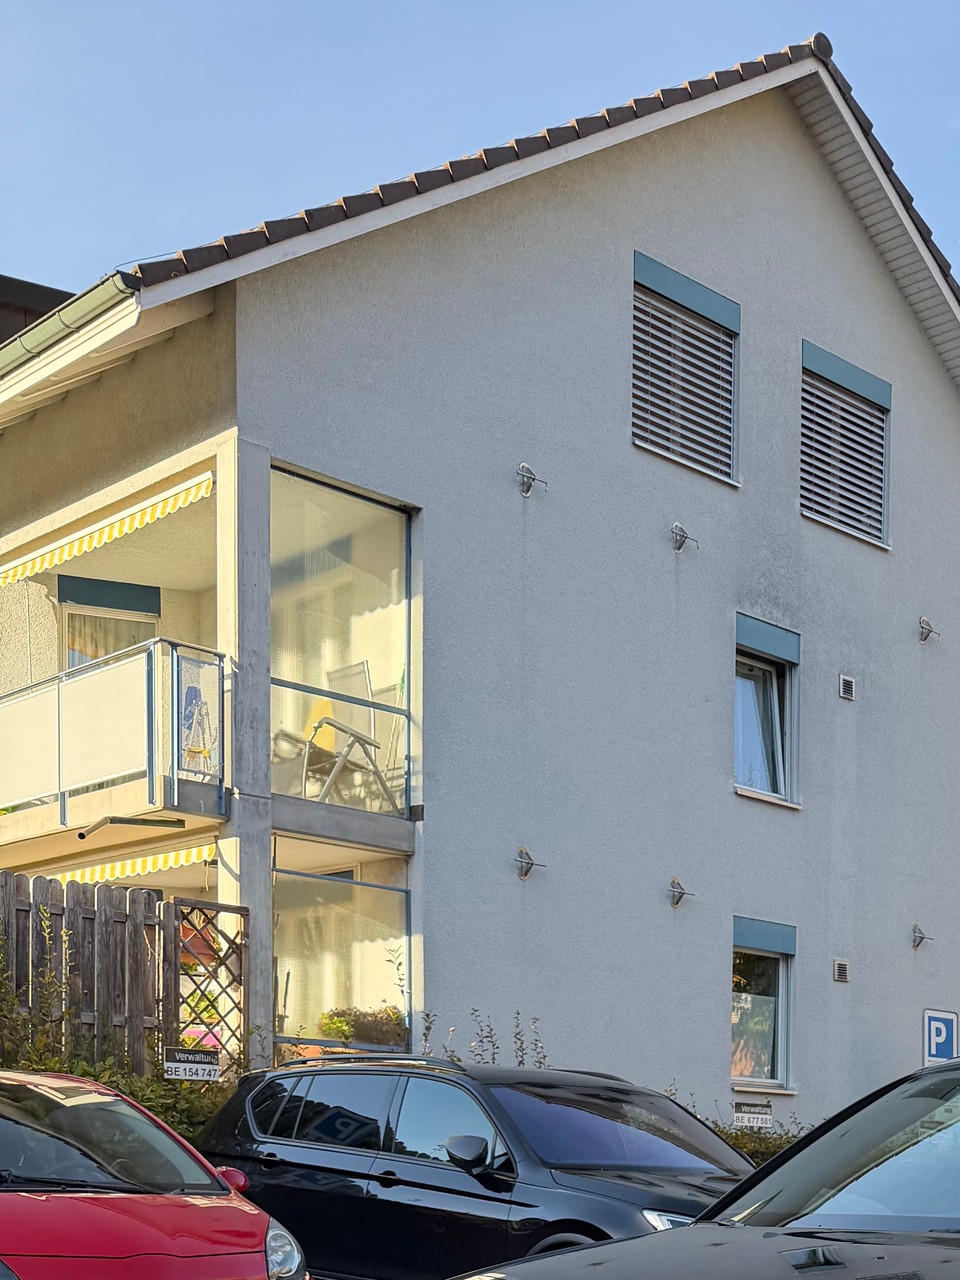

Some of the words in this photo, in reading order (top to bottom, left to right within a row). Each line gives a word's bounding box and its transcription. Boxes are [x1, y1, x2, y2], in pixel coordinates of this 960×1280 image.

[931, 1021, 947, 1054] P
[166, 1067, 180, 1076] BE
[183, 1068, 199, 1077] 154
[201, 1069, 217, 1078] 747
